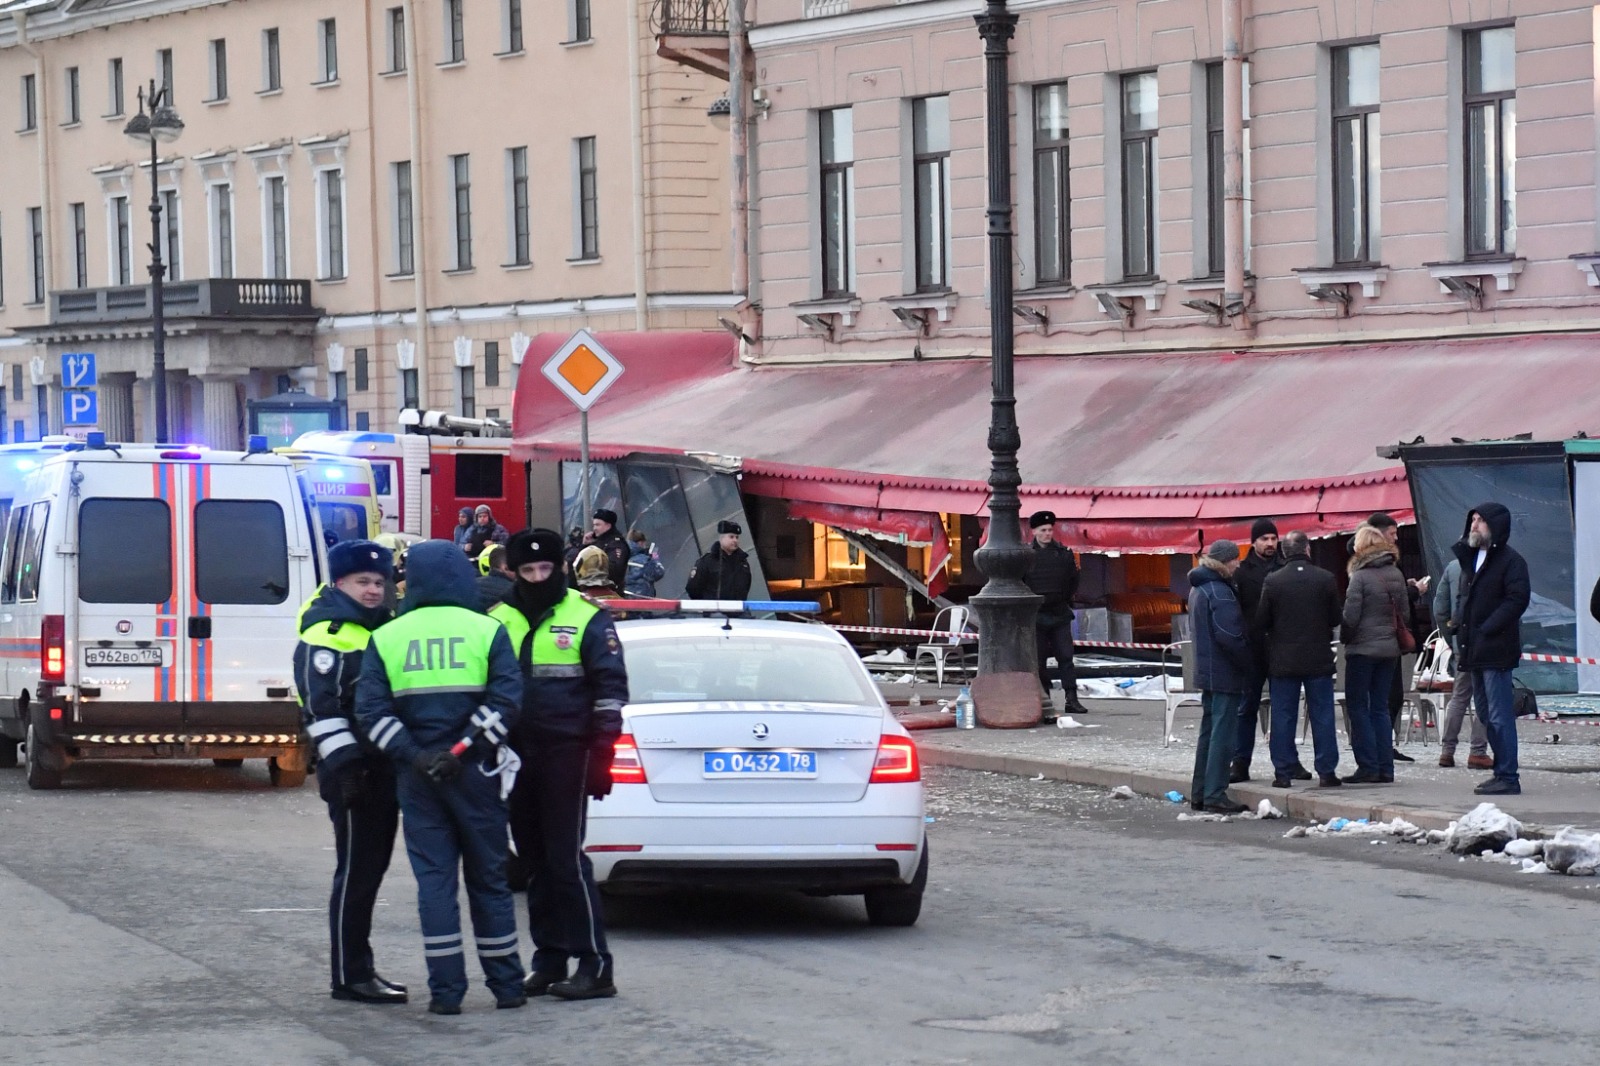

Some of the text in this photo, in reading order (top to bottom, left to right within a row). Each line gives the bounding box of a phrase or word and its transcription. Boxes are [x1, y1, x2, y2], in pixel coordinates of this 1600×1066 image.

[71, 393, 91, 421] P
[403, 637, 466, 672] ДПС
[731, 754, 780, 771] 0432
[791, 754, 810, 767] 78
